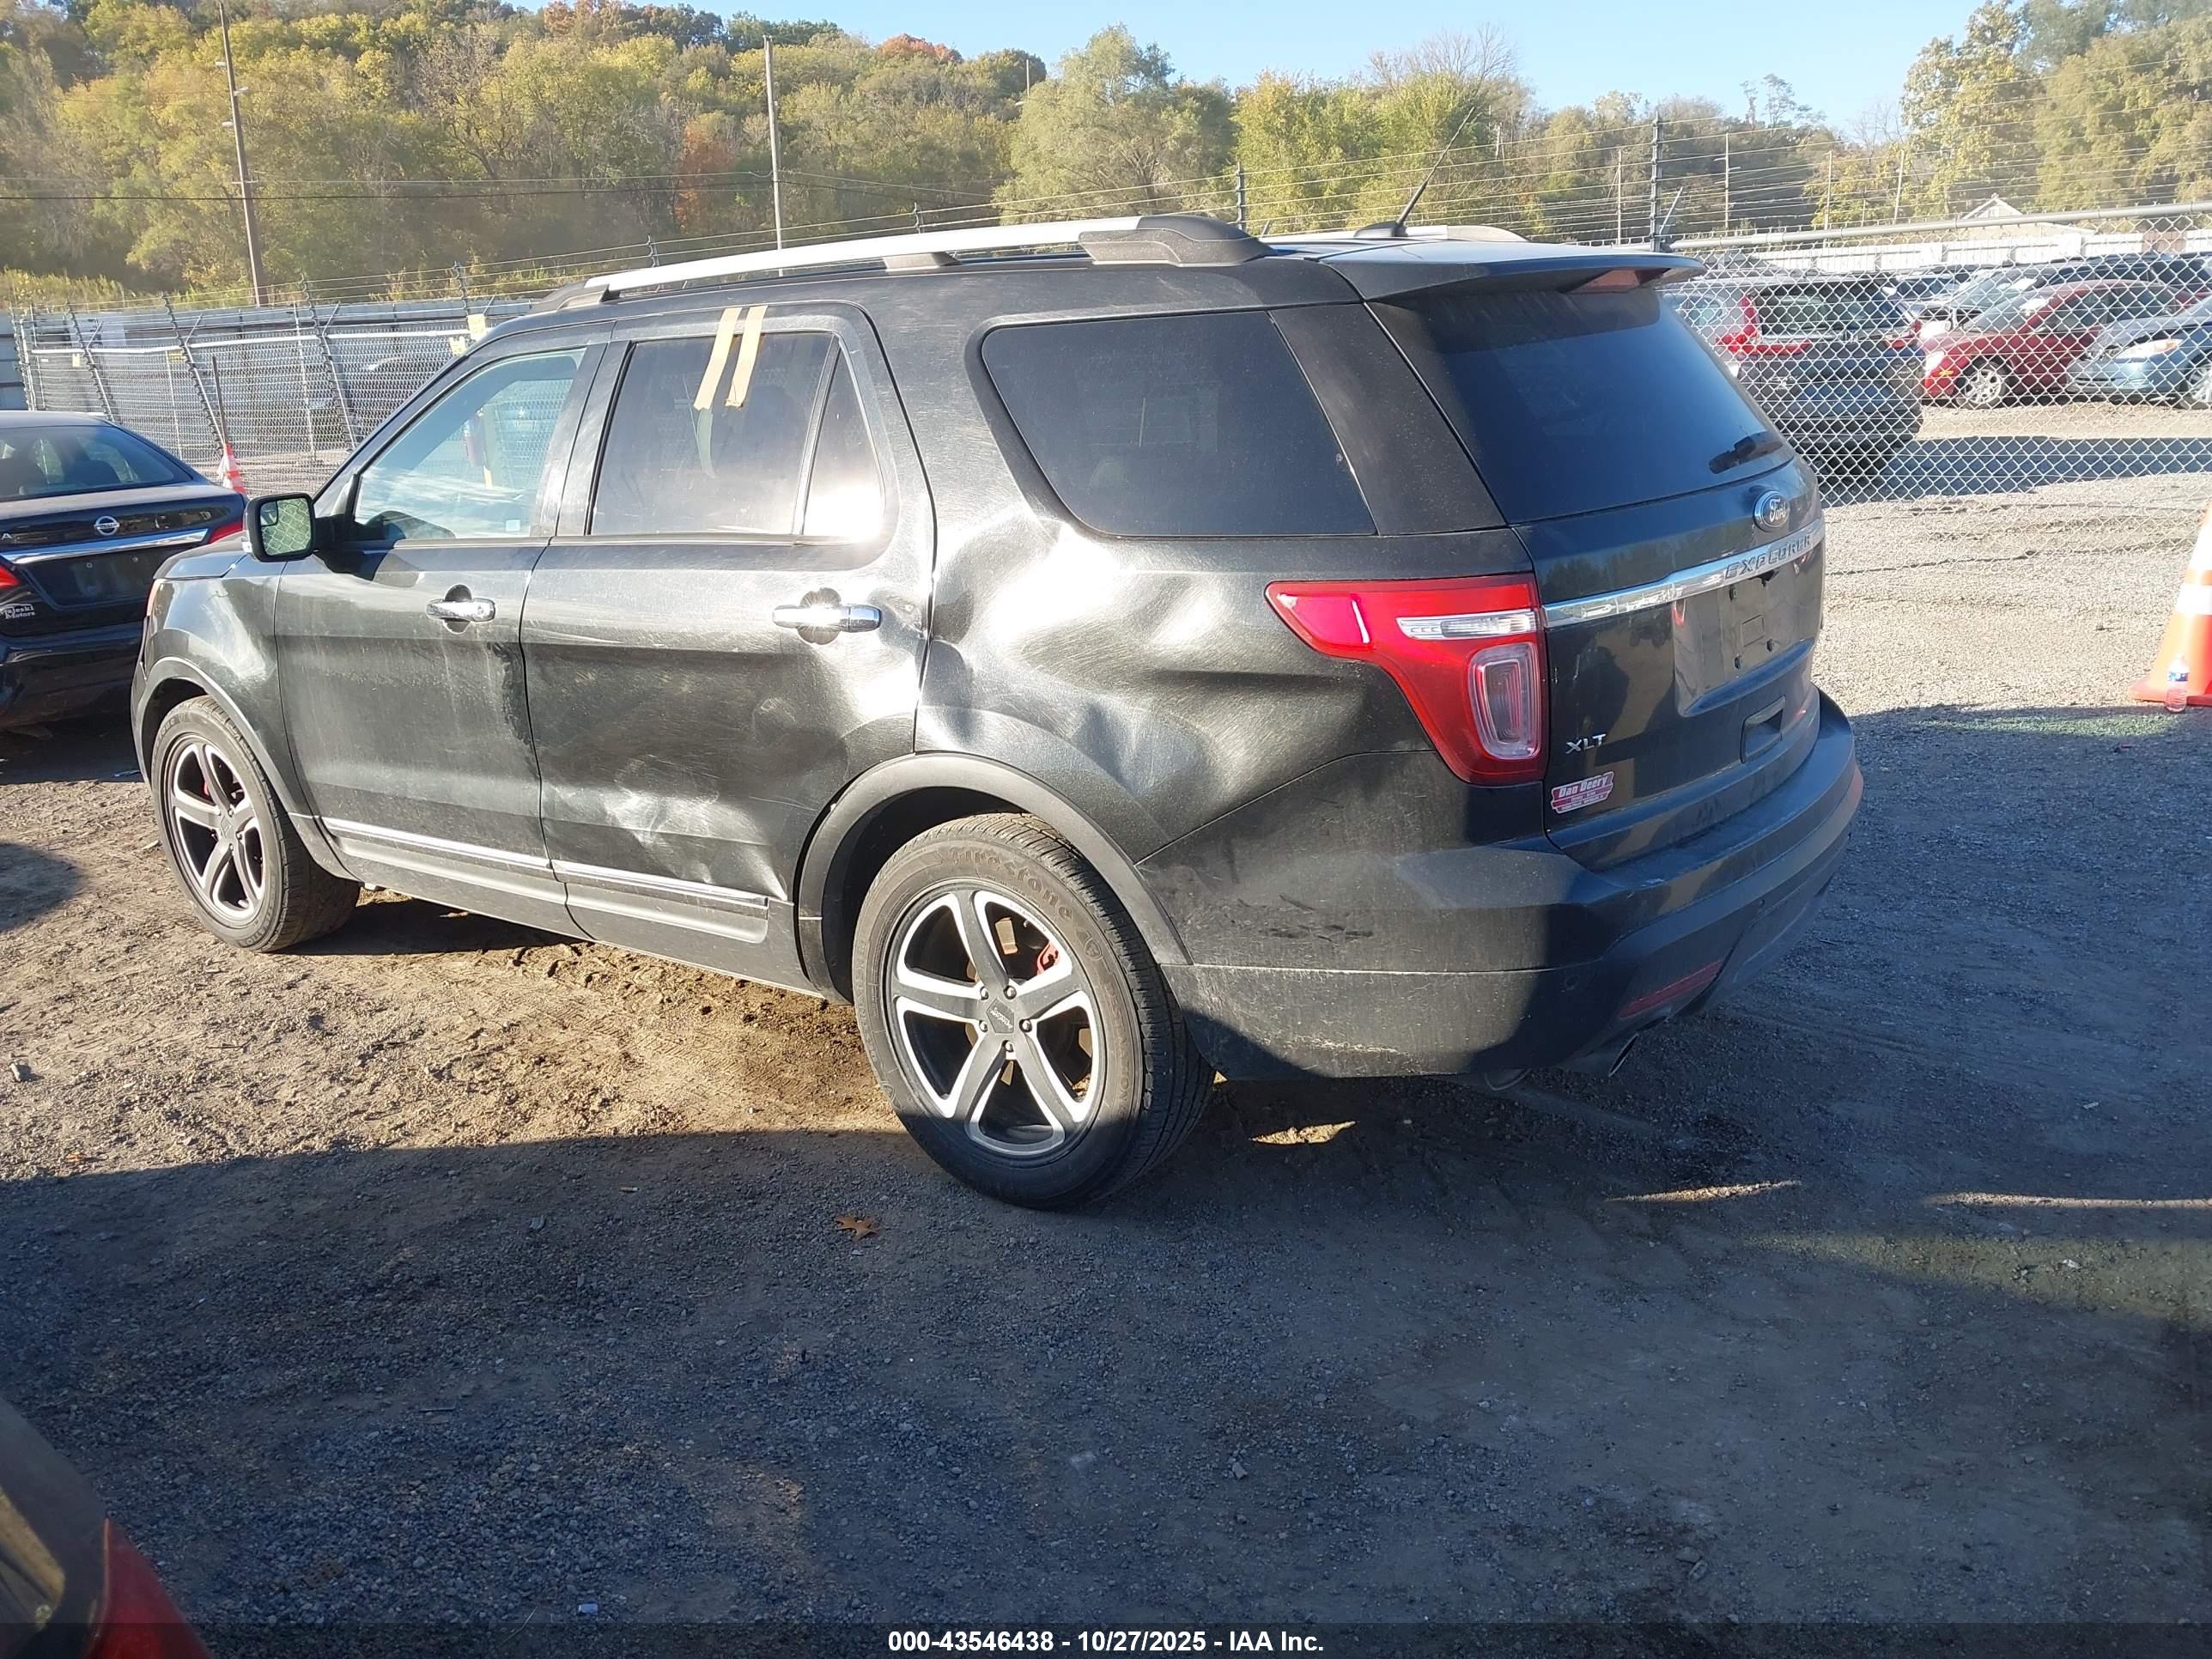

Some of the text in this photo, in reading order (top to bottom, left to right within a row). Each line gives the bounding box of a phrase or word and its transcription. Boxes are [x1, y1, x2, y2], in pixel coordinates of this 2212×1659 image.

[1769, 497, 1787, 523] Ford
[1724, 534, 1812, 580] EXPLORER
[5, 611, 35, 619] Motors
[1566, 733, 1606, 754] XLT
[1559, 785, 1579, 799] Dan
[1580, 775, 1608, 792] Deery
[949, 845, 1073, 921] Firestone
